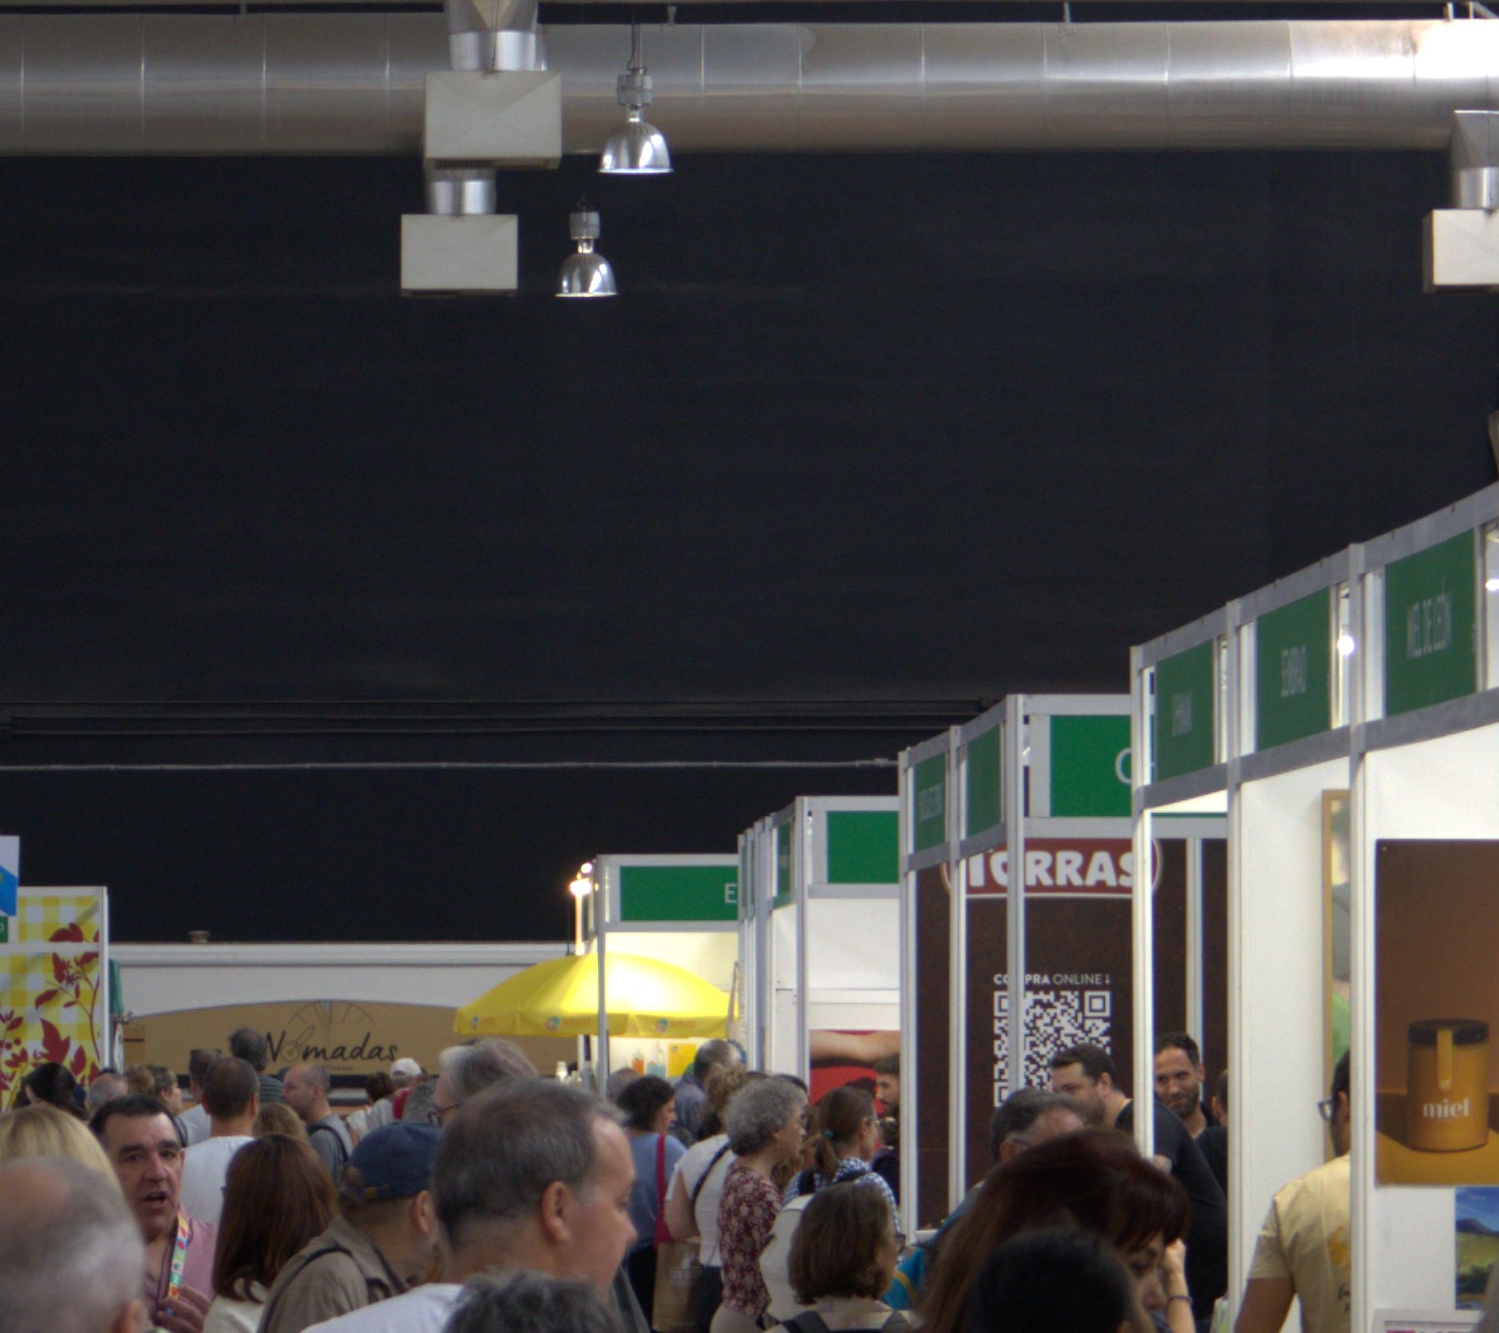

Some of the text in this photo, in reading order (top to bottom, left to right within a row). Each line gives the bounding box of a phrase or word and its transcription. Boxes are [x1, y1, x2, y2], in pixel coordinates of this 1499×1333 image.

[993, 973, 1102, 986] COPRA ONLINE
[1423, 1097, 1470, 1119] miel
